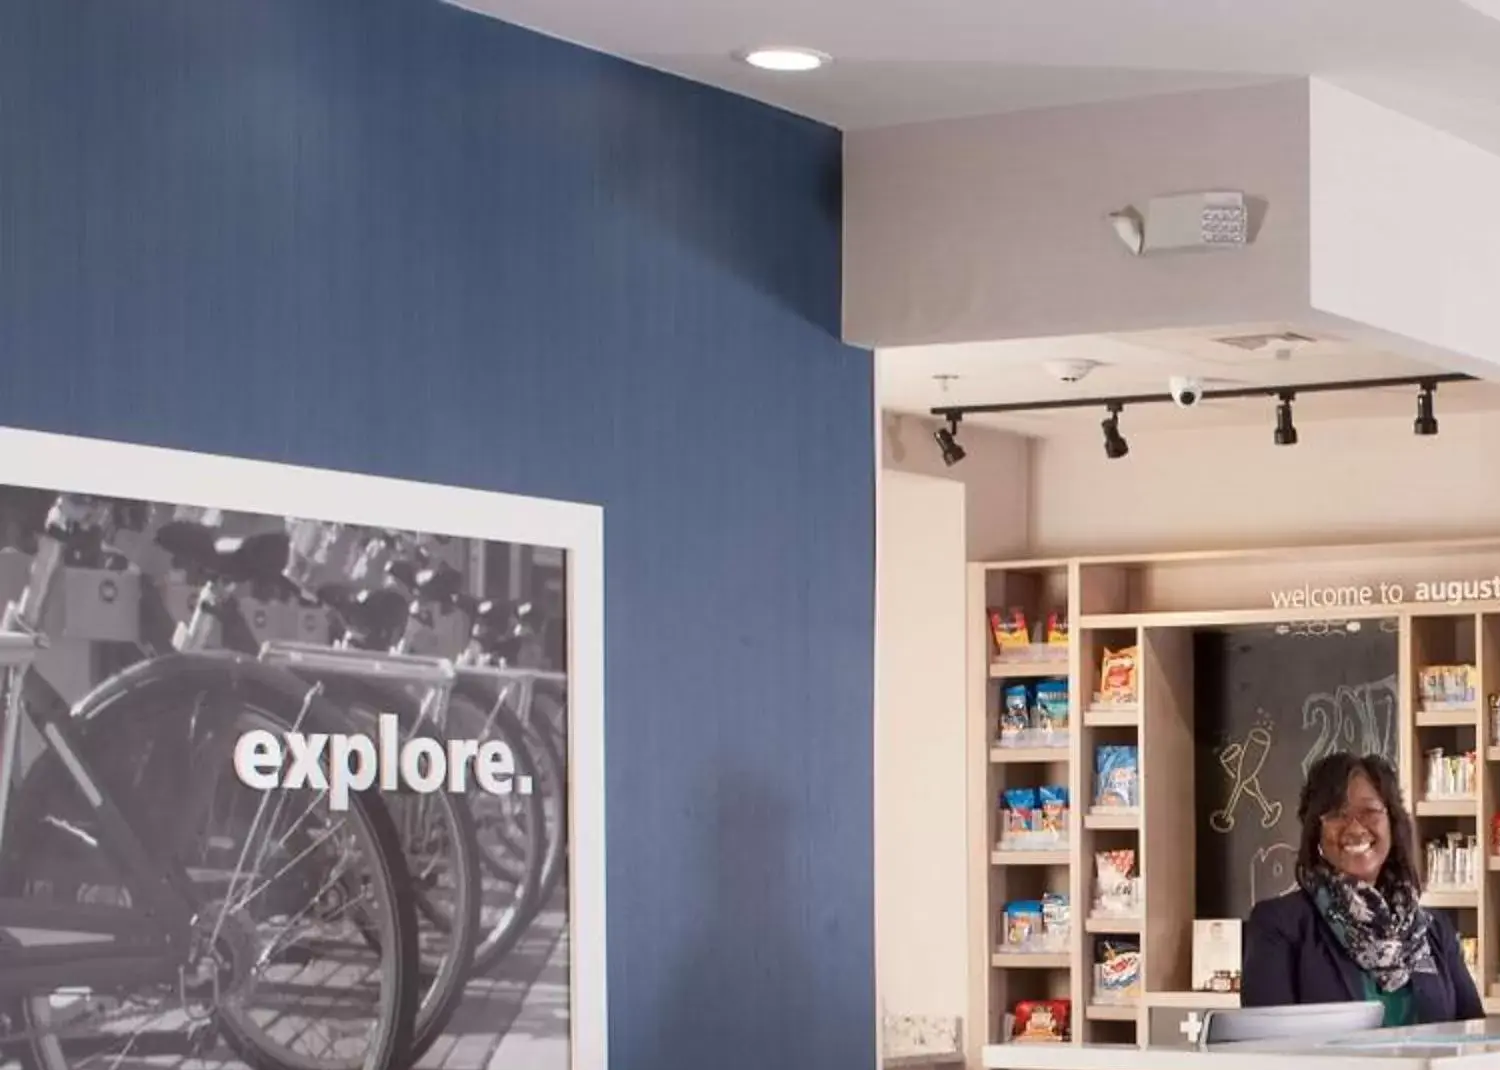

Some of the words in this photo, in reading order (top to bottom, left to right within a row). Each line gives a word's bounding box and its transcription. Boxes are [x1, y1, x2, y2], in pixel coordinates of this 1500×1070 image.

[1270, 583, 1373, 608] welcome
[1379, 581, 1403, 604] to
[233, 713, 533, 811] explore.
